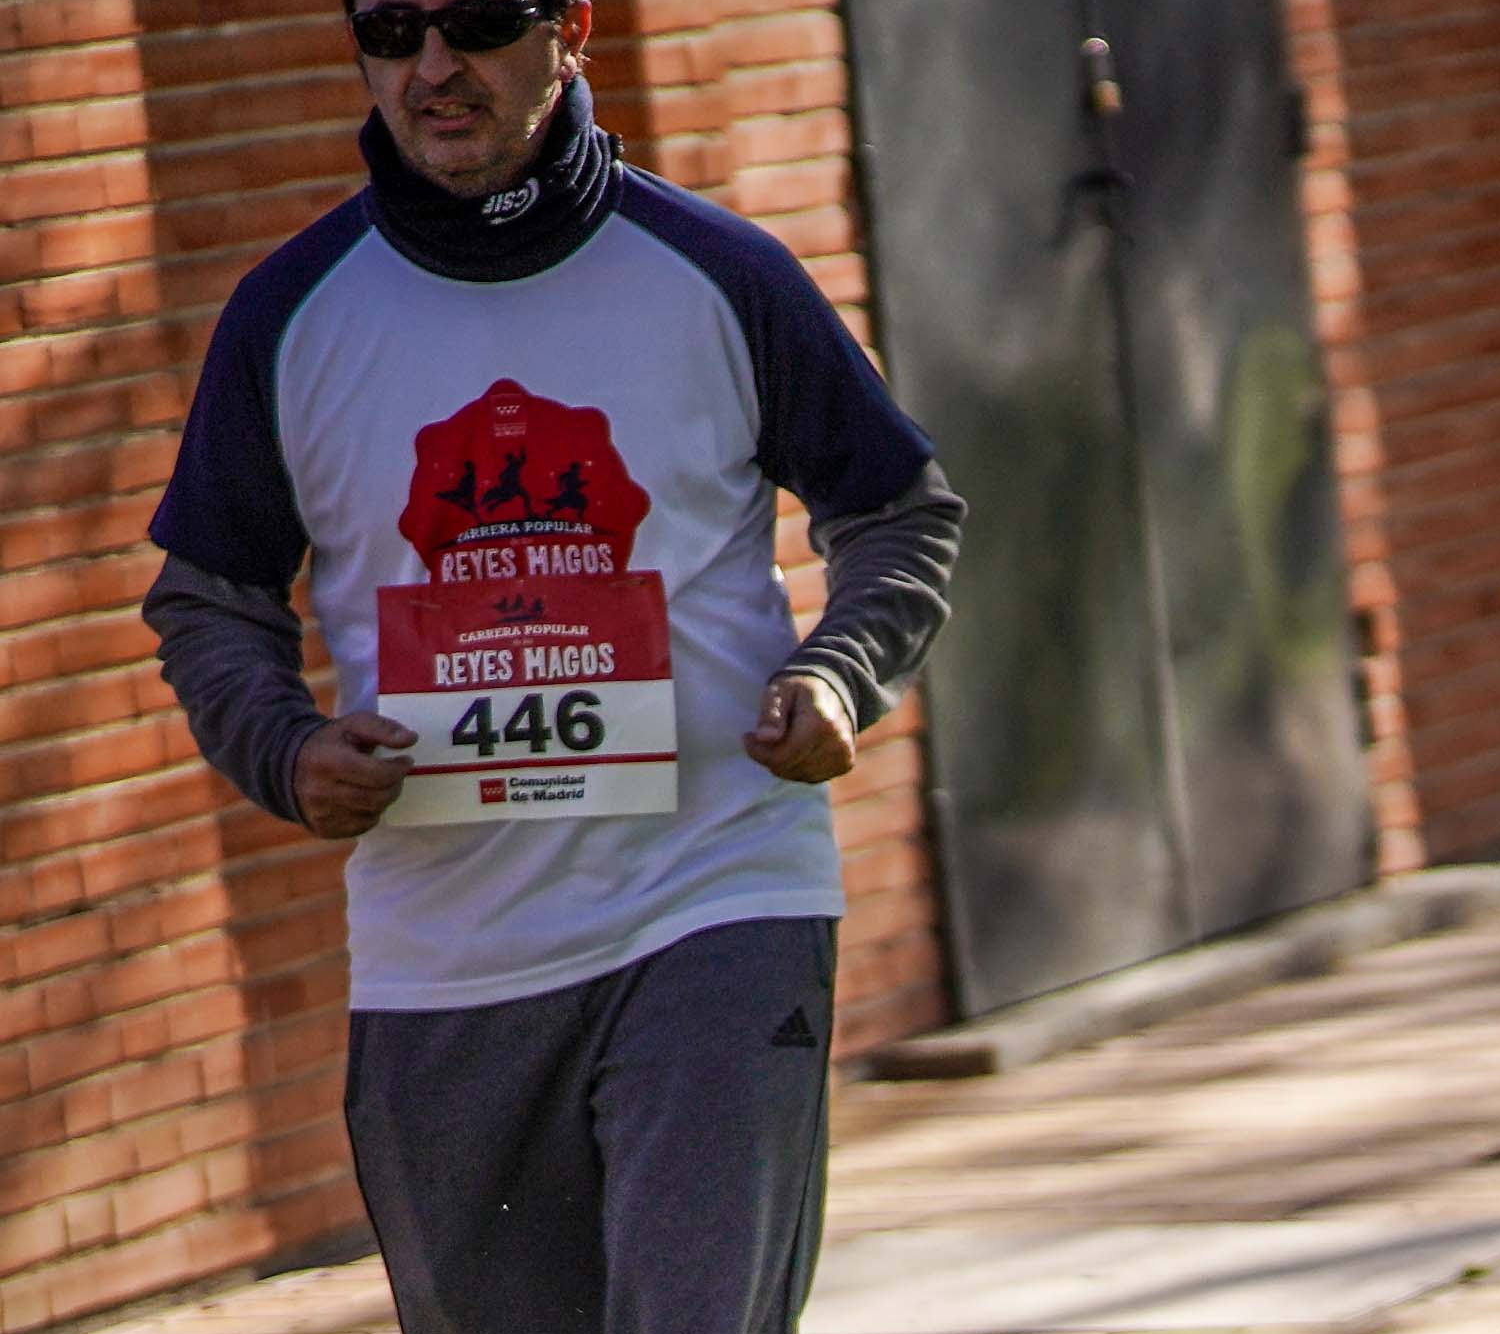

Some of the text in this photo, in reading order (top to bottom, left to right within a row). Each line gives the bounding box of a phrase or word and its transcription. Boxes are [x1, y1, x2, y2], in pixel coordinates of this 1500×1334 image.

[523, 521, 594, 535] POPULAR
[441, 543, 614, 582] REYES MAGOS
[459, 625, 522, 643] CARRERA
[524, 624, 590, 636] POPULAR
[435, 643, 615, 685] REYES MAGOS
[452, 689, 606, 756] 446
[509, 774, 586, 788] Comunidad
[533, 788, 585, 801] Madrid
